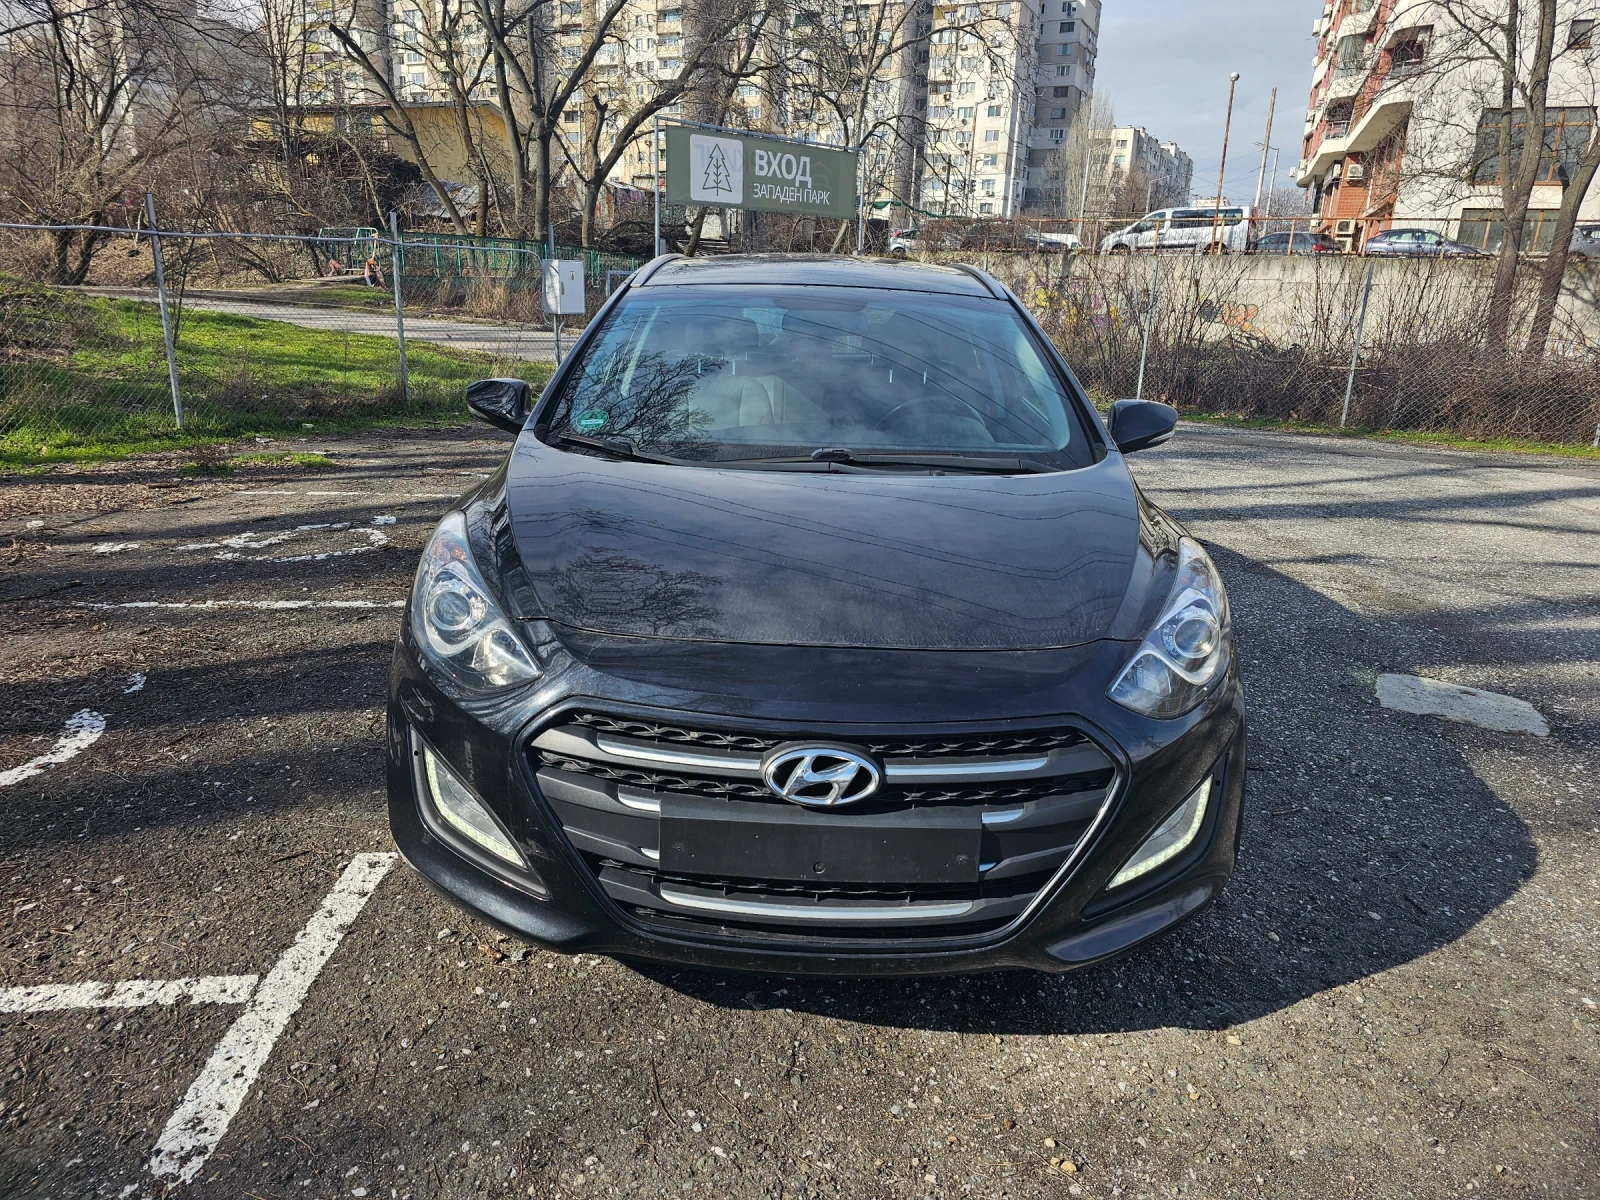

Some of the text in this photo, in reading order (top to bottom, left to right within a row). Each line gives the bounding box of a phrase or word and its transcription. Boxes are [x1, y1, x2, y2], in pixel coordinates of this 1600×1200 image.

[755, 149, 812, 189] ВХОД
[752, 182, 803, 204] ЗАПАДЕН
[804, 188, 831, 206] ПАРК
